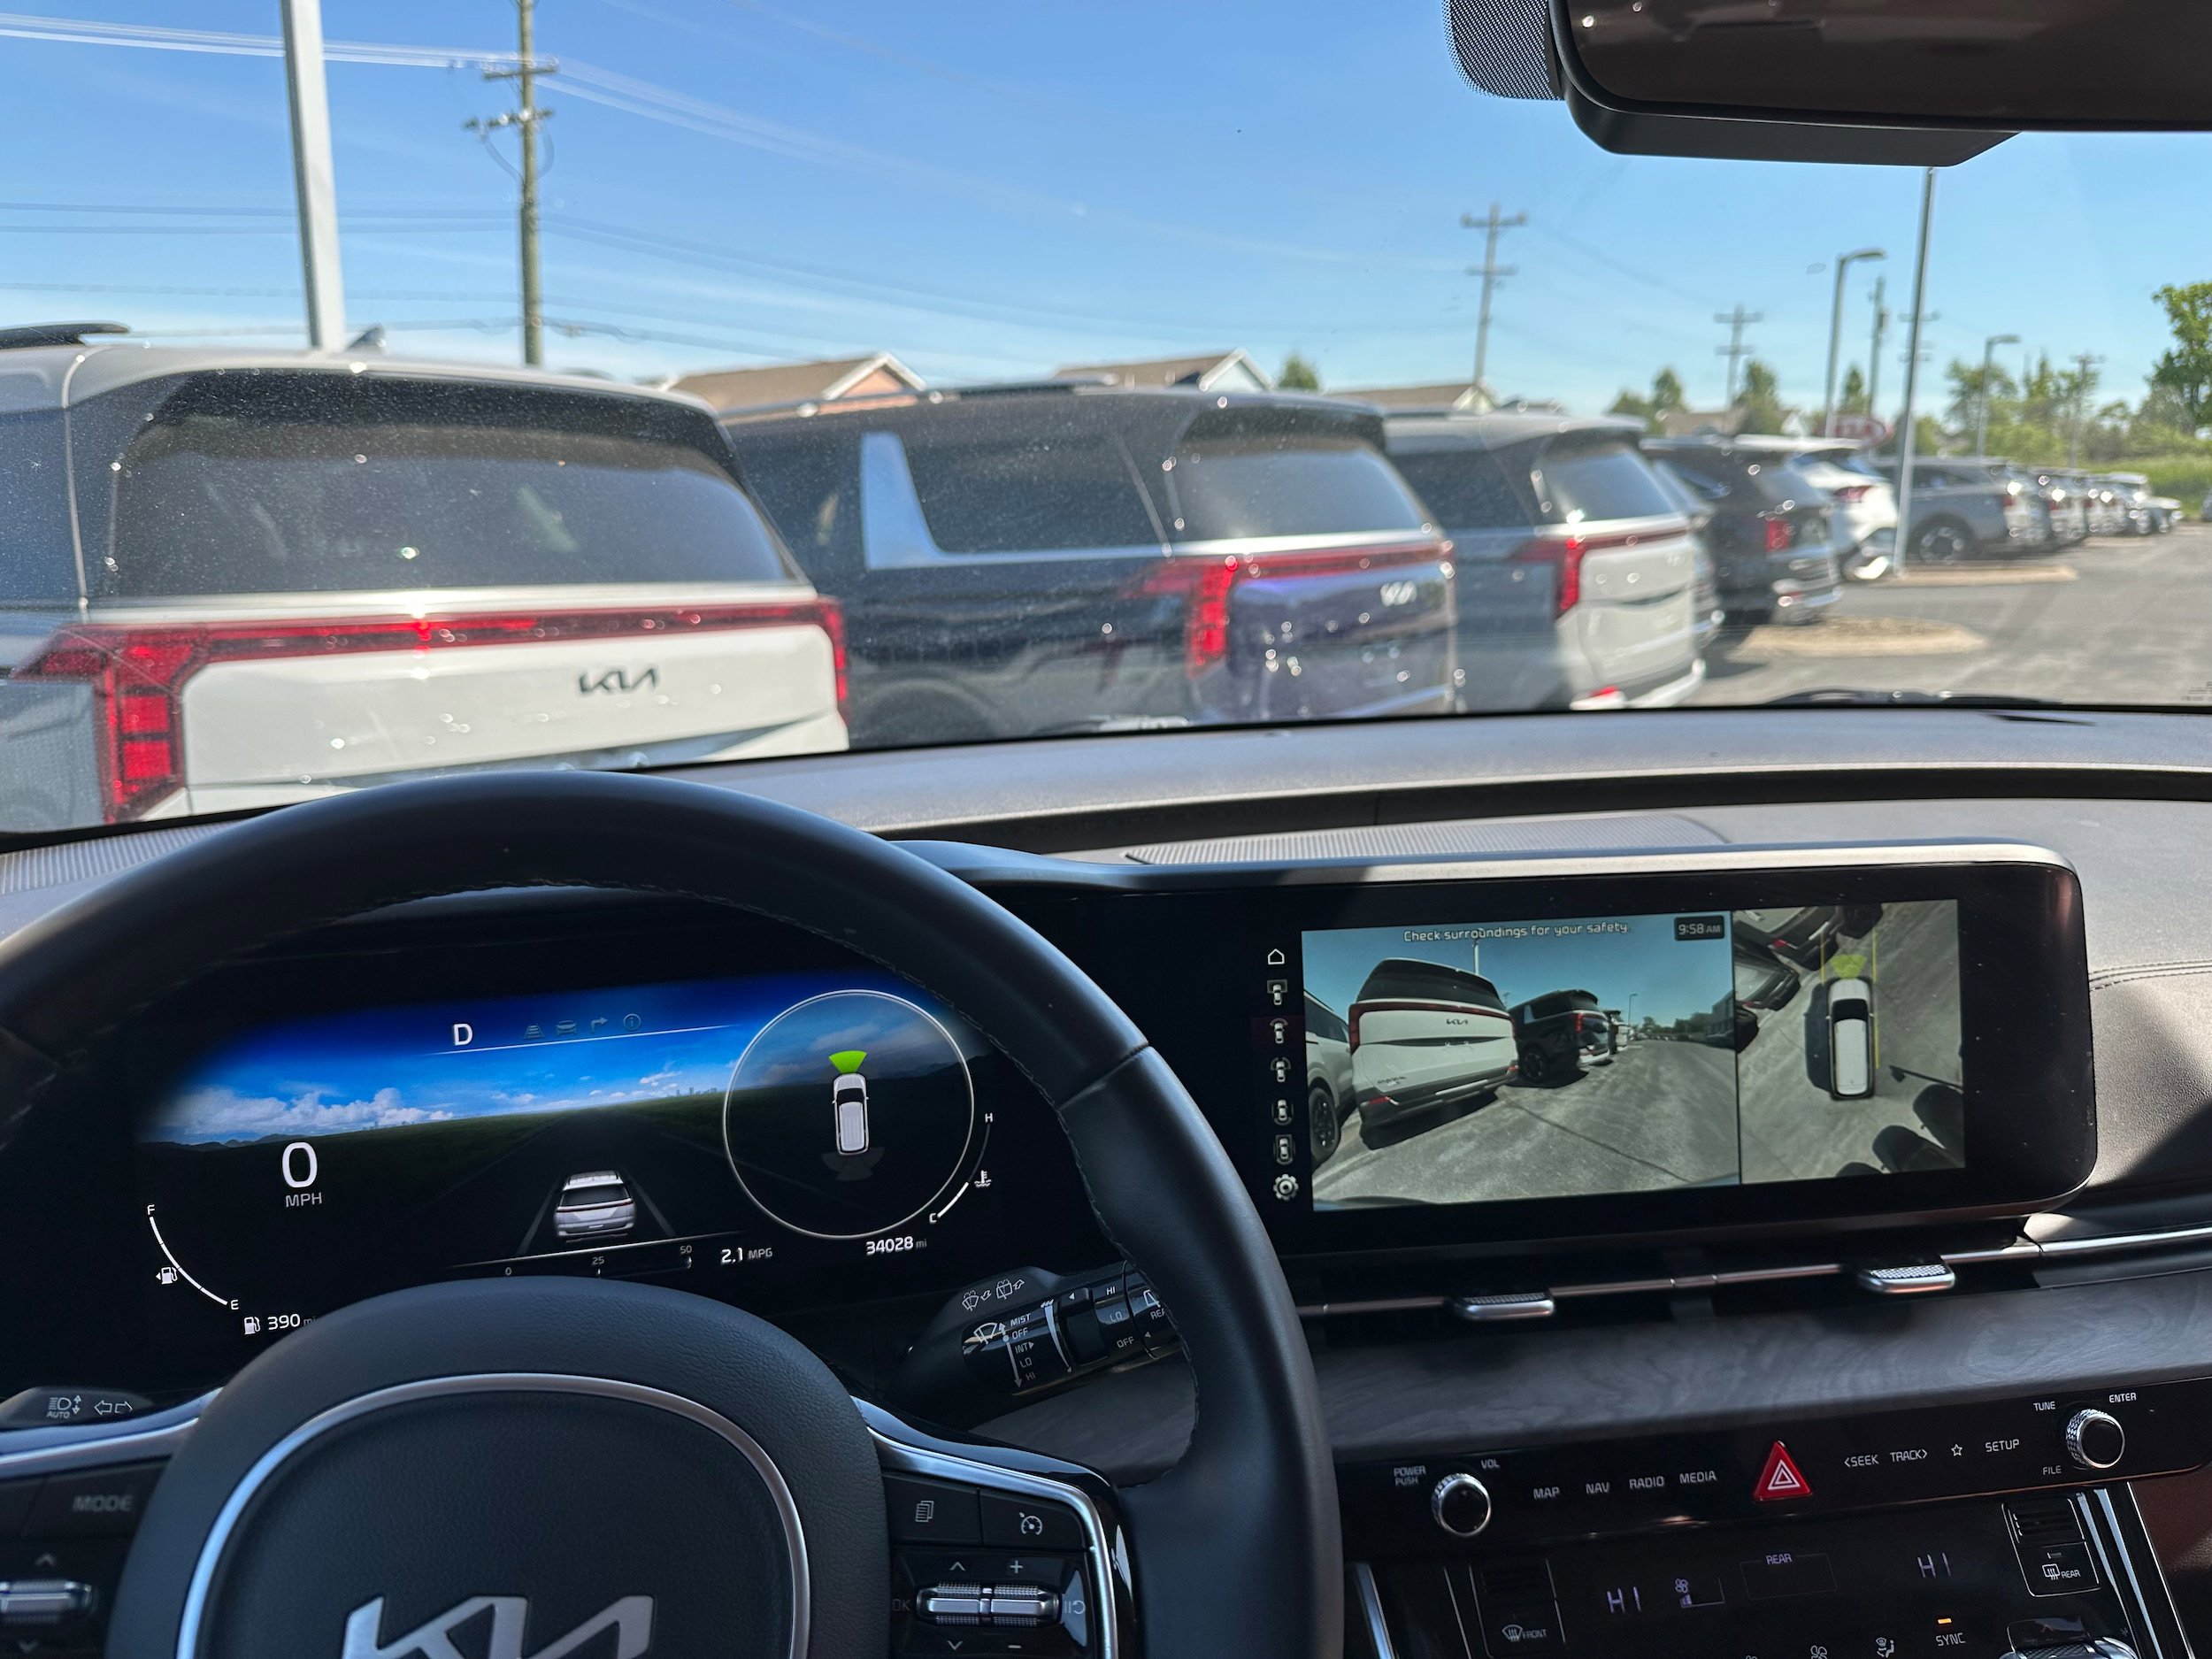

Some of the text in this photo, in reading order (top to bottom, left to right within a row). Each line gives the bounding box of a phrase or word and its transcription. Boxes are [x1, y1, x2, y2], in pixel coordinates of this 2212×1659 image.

[579, 668, 657, 693] KIA
[1404, 931, 1440, 941] Check
[1444, 926, 1527, 941] surroundings
[1531, 926, 1550, 935] for
[1554, 924, 1583, 937] your
[1678, 923, 1721, 935] 9:58 AM
[452, 1024, 473, 1046] D
[984, 1112, 994, 1123] H
[281, 1141, 319, 1188] 0
[285, 1192, 323, 1209] MPH
[147, 1204, 156, 1216] F
[928, 1212, 938, 1224] C
[680, 1245, 693, 1255] 50
[865, 1236, 927, 1256] 34028 mi
[592, 1256, 605, 1266] 25
[720, 1248, 773, 1264] 2.1 MPG
[504, 1267, 513, 1277] 0
[1106, 1286, 1117, 1296] HI
[230, 1299, 240, 1310] E
[267, 1313, 301, 1331] 390
[1010, 1313, 1032, 1327] MIST
[1110, 1311, 1124, 1323] LO
[1011, 1328, 1029, 1340] OFF
[1015, 1341, 1029, 1355] INT
[1117, 1336, 1135, 1349] OFF
[1019, 1357, 1033, 1369] LO
[1025, 1372, 1036, 1381] HI
[2108, 1392, 2138, 1403] ENTER
[2033, 1401, 2056, 1412] TUNE
[46, 1410, 71, 1419] AUTO
[1985, 1439, 2021, 1454] SETUP
[1480, 1459, 1501, 1470] VOL
[2042, 1464, 2062, 1476] FILE
[1394, 1465, 1426, 1478] POWER
[1678, 1470, 1717, 1485] MEDIA
[1394, 1477, 1419, 1486] PUSH
[1628, 1475, 1665, 1491] RADIO
[1532, 1486, 1561, 1500] MAP
[1585, 1482, 1610, 1494] NAV
[72, 1494, 134, 1513] MODE
[1765, 1553, 1793, 1565] REAR
[2061, 1570, 2081, 1579] REAR
[891, 1598, 911, 1612] OK
[1522, 1629, 1547, 1639] FRONT
[1935, 1632, 1966, 1647] SYNC
